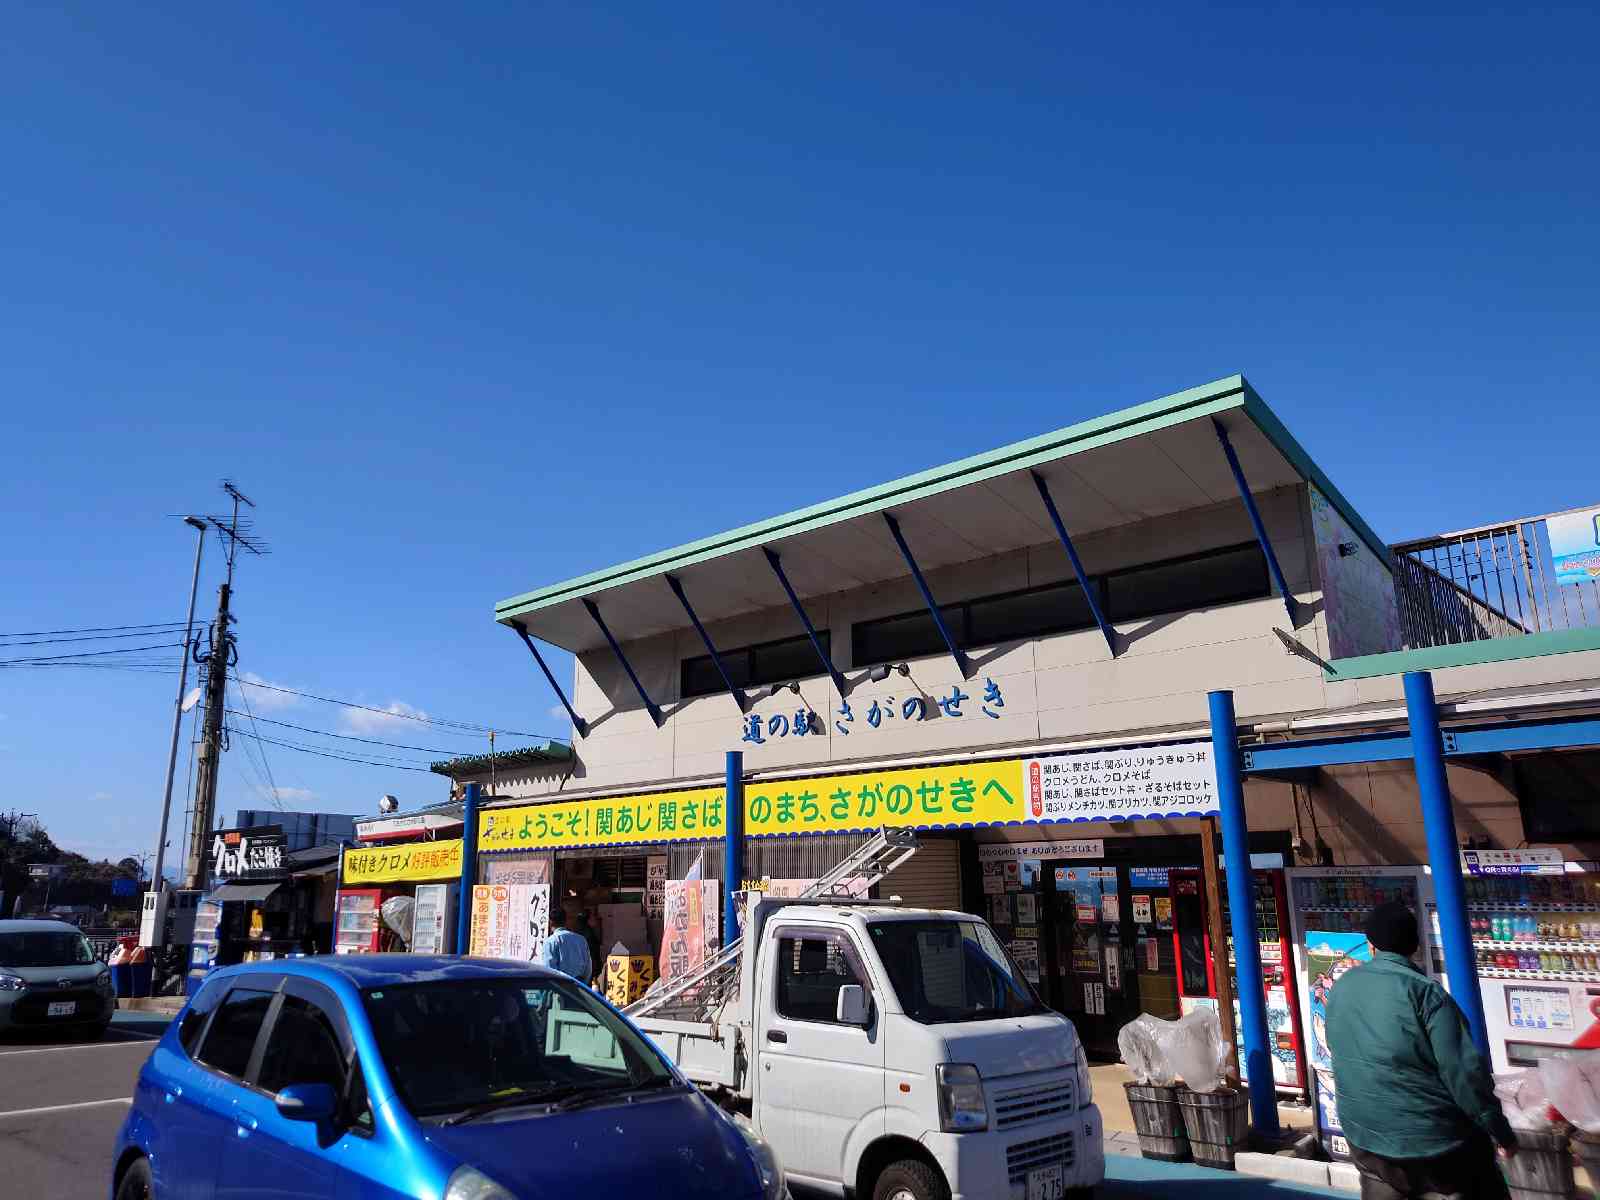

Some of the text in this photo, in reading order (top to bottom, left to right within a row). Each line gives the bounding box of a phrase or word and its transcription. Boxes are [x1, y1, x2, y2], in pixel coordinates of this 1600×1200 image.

[742, 677, 1005, 745] 道の駅 さがのせき
[749, 777, 1014, 824] のまち、さがのせきへ
[529, 894, 540, 960] クロメ
